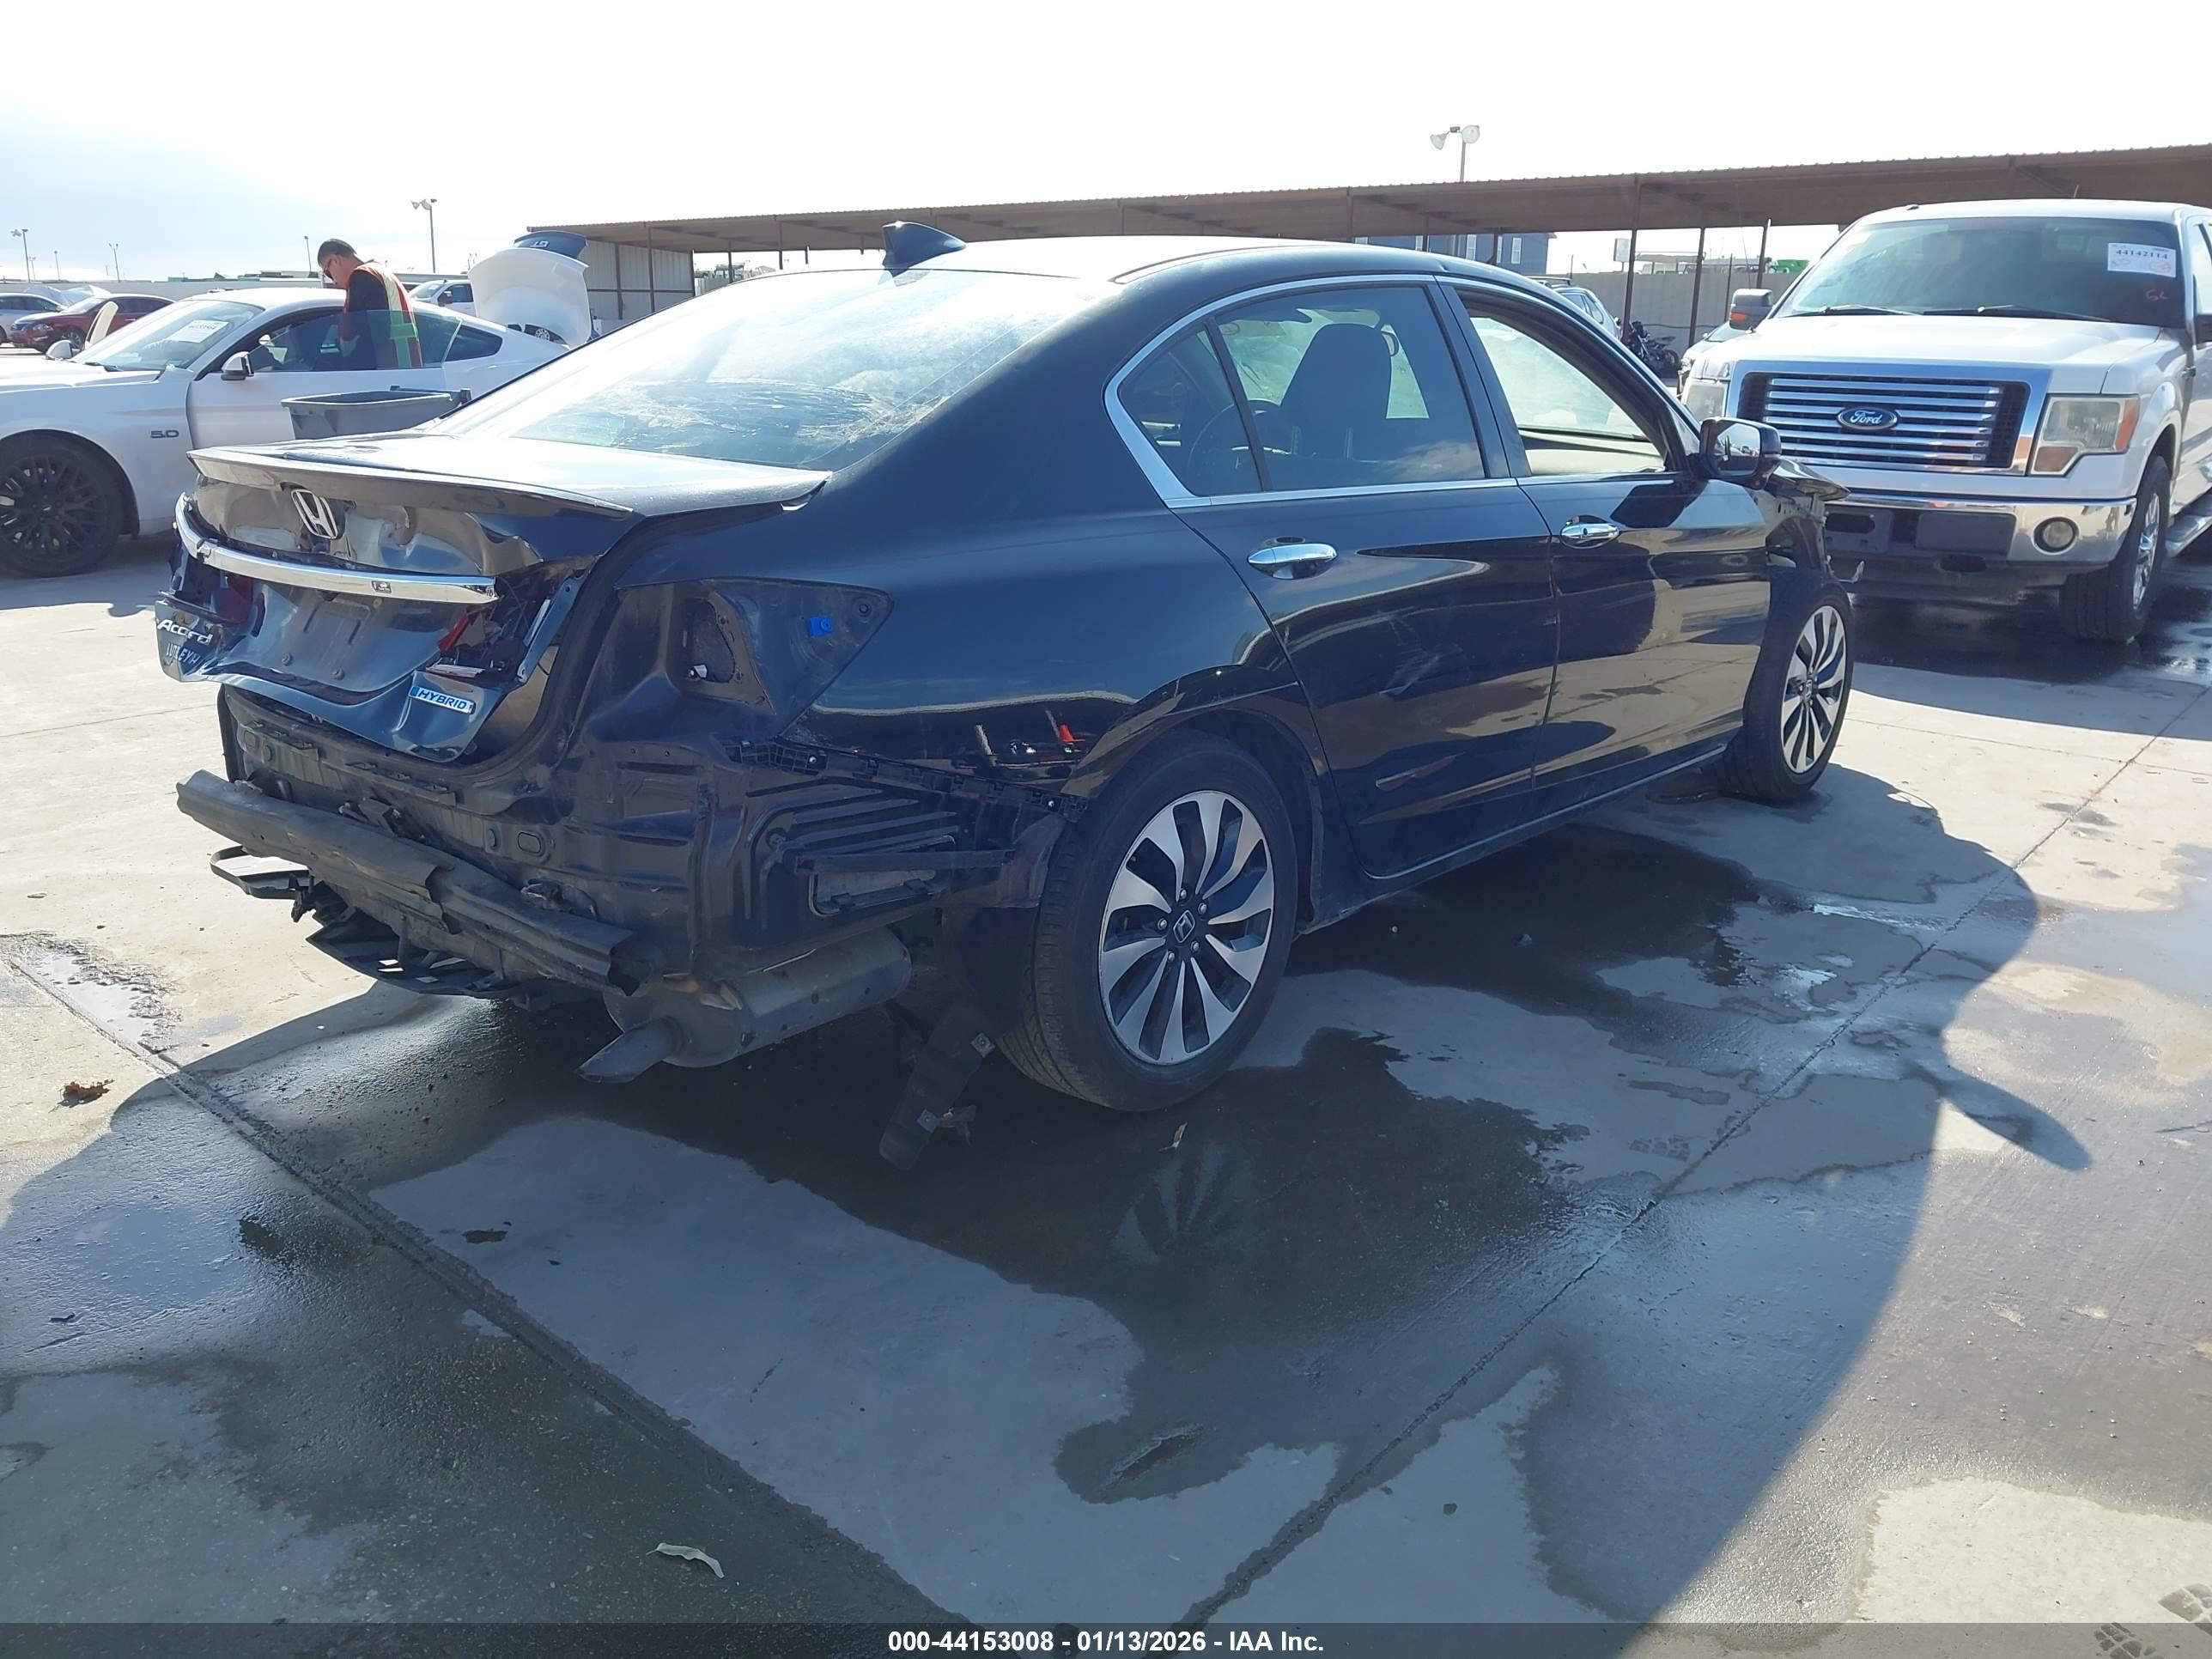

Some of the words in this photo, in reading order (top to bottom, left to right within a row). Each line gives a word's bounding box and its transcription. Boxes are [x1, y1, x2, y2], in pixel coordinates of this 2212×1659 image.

[1850, 410, 1883, 425] Ford
[150, 430, 179, 439] 5.0
[156, 618, 214, 647] Accord
[417, 689, 468, 710] HYBRID
